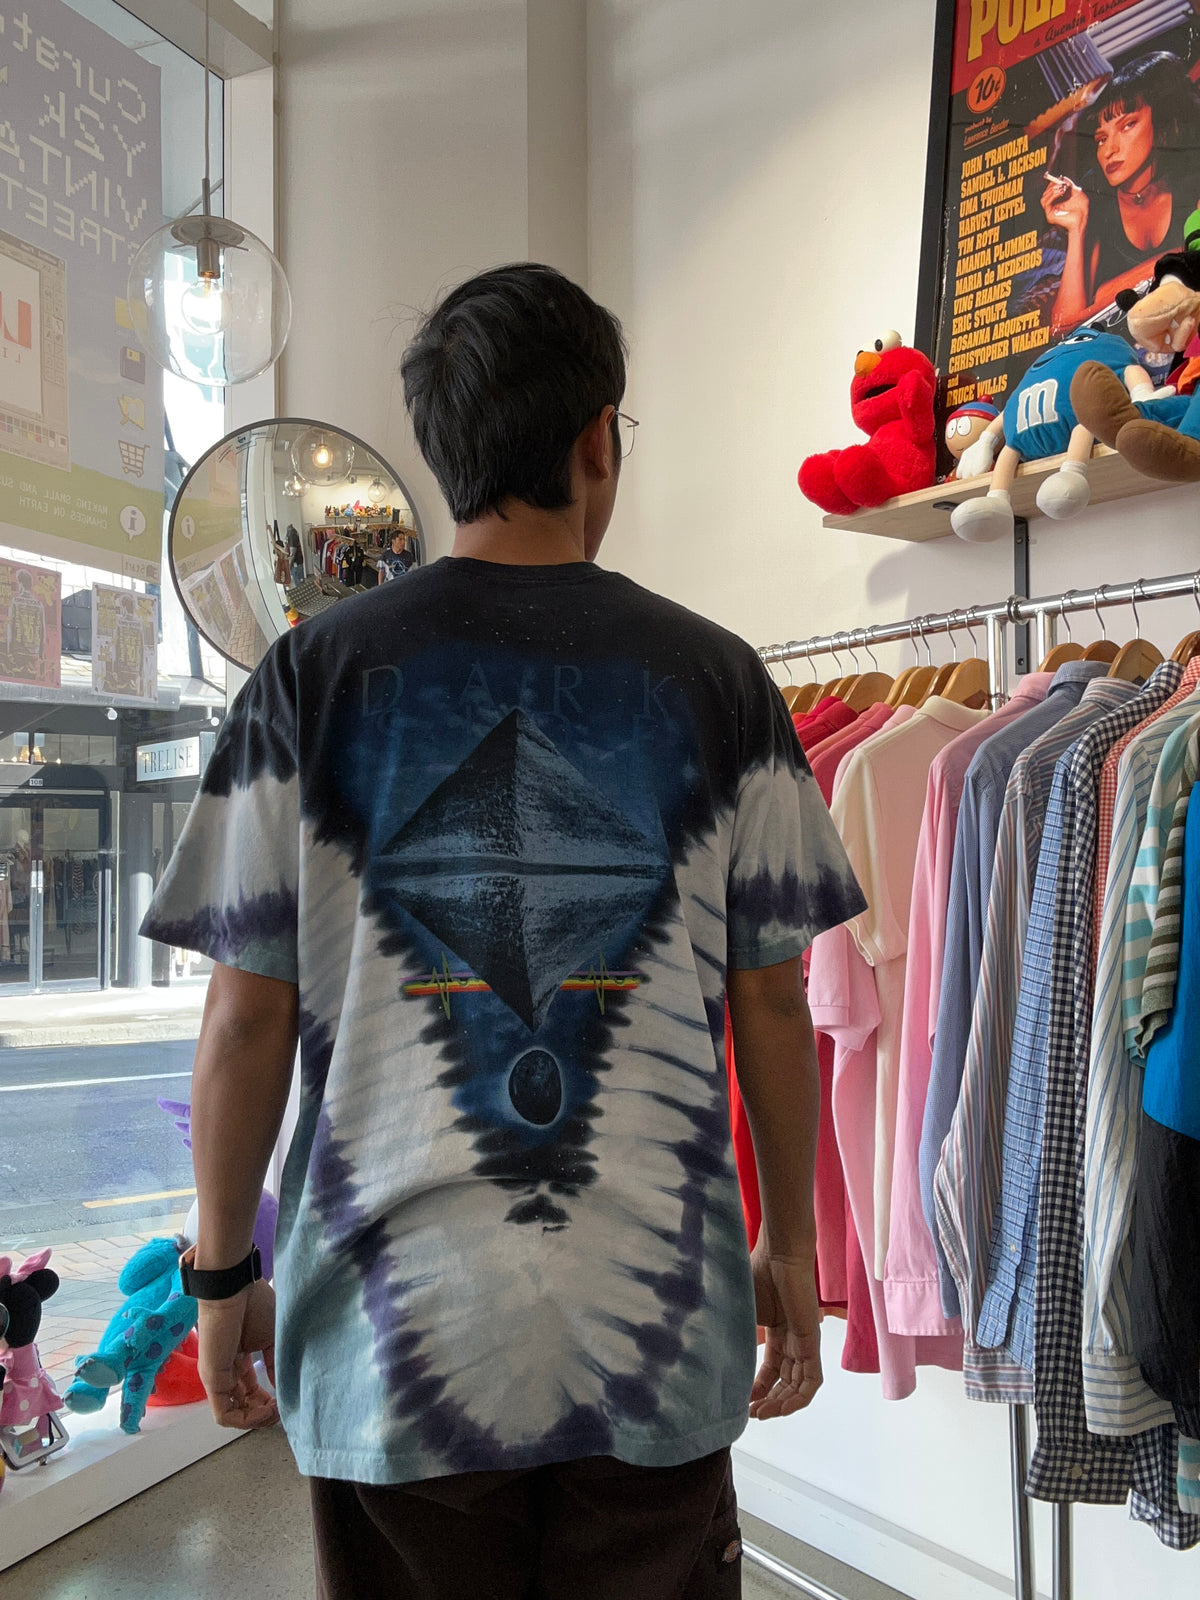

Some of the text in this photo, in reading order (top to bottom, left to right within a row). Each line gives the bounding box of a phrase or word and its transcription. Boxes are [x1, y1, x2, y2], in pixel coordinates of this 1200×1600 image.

[961, 135, 1028, 180] JOHN TRAVOLTA
[961, 146, 1047, 198] SAMUEL L. JACKSON
[959, 196, 1026, 238] HARVEY KEITEL
[960, 176, 1024, 218] UMA THURMAN
[956, 230, 1037, 277] AMANDA PLUMMER
[958, 226, 1000, 257] TIM ROTH
[955, 248, 1042, 297] MARIA de MEDEIROS
[952, 300, 1007, 336] ERIC STOLTZ
[954, 279, 1012, 315] VING RHAMES
[949, 326, 1049, 374] CHRISTOPHER WALKEN
[950, 309, 1040, 355] ROSANNA ARQUETTE
[946, 374, 1007, 407] BRUCE WILLIS
[948, 374, 959, 388] and
[143, 745, 193, 773] TRELISE
